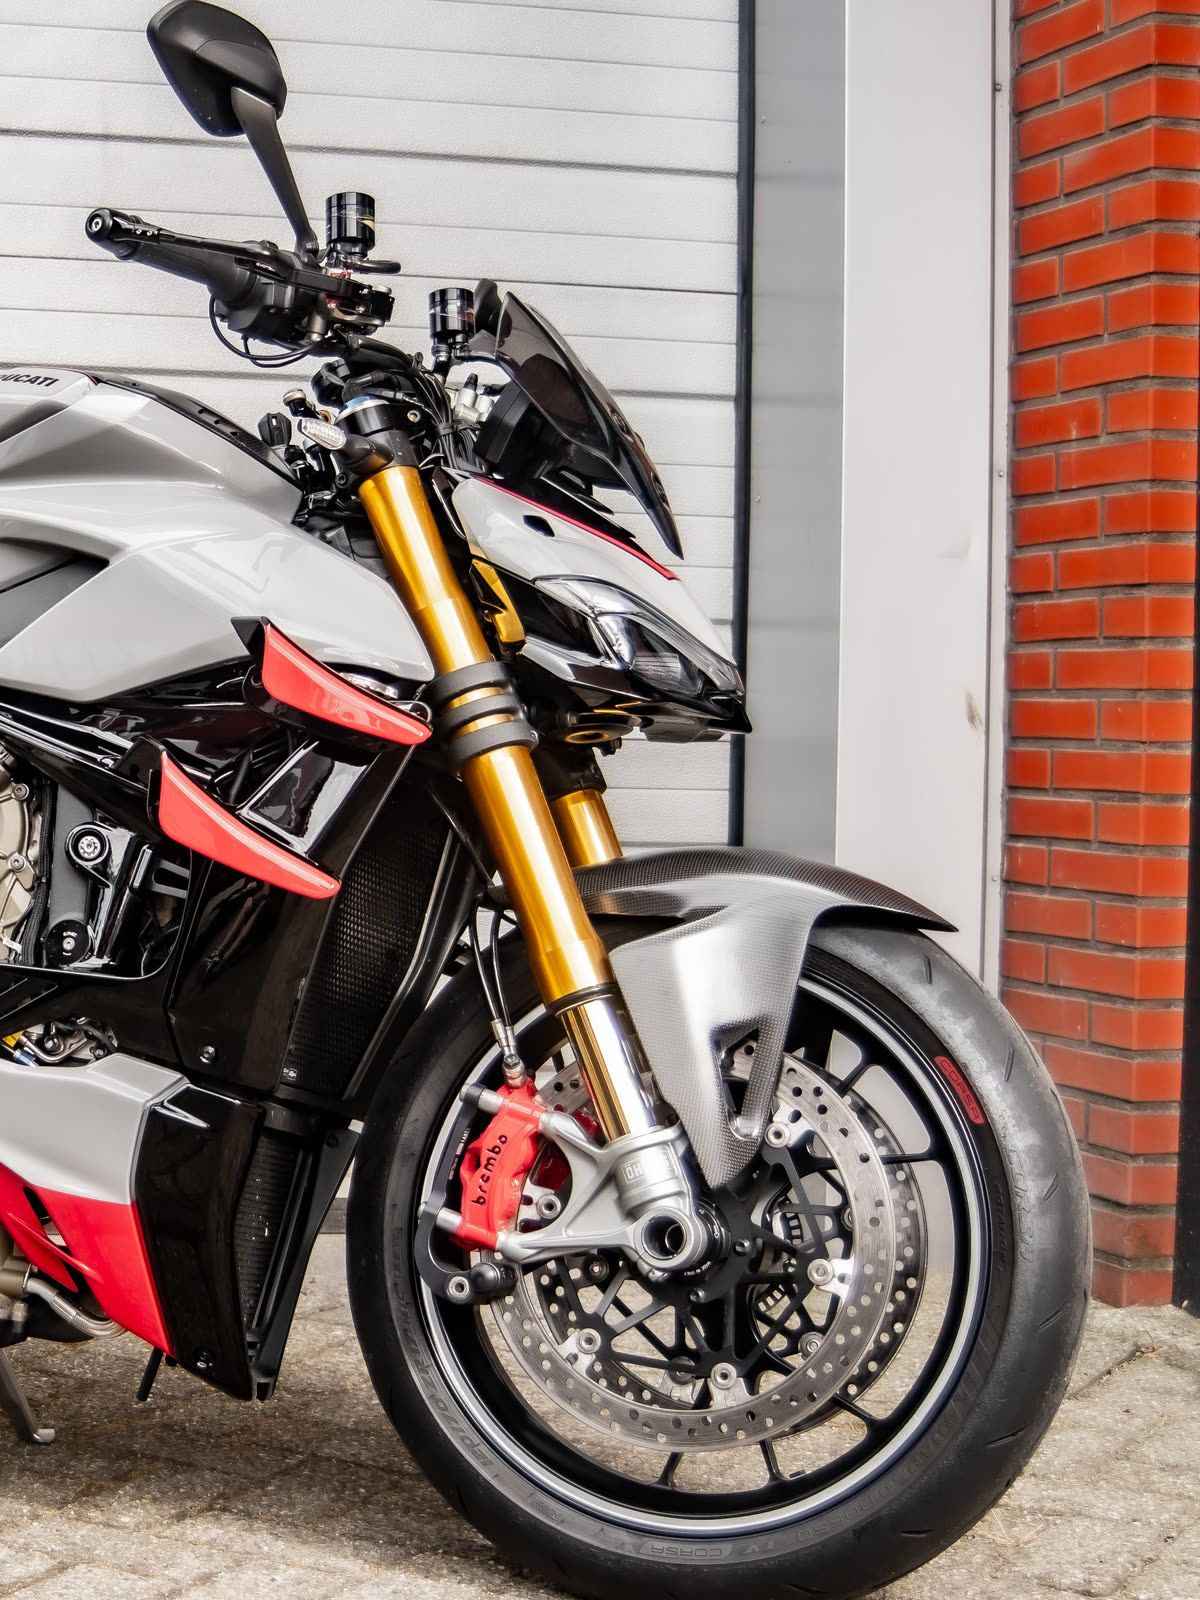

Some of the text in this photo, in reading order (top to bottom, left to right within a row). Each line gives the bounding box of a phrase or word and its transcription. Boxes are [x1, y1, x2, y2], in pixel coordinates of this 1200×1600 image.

[939, 1057, 980, 1121] CORSA
[471, 1134, 508, 1206] brembo
[650, 1543, 724, 1558] CORSA
